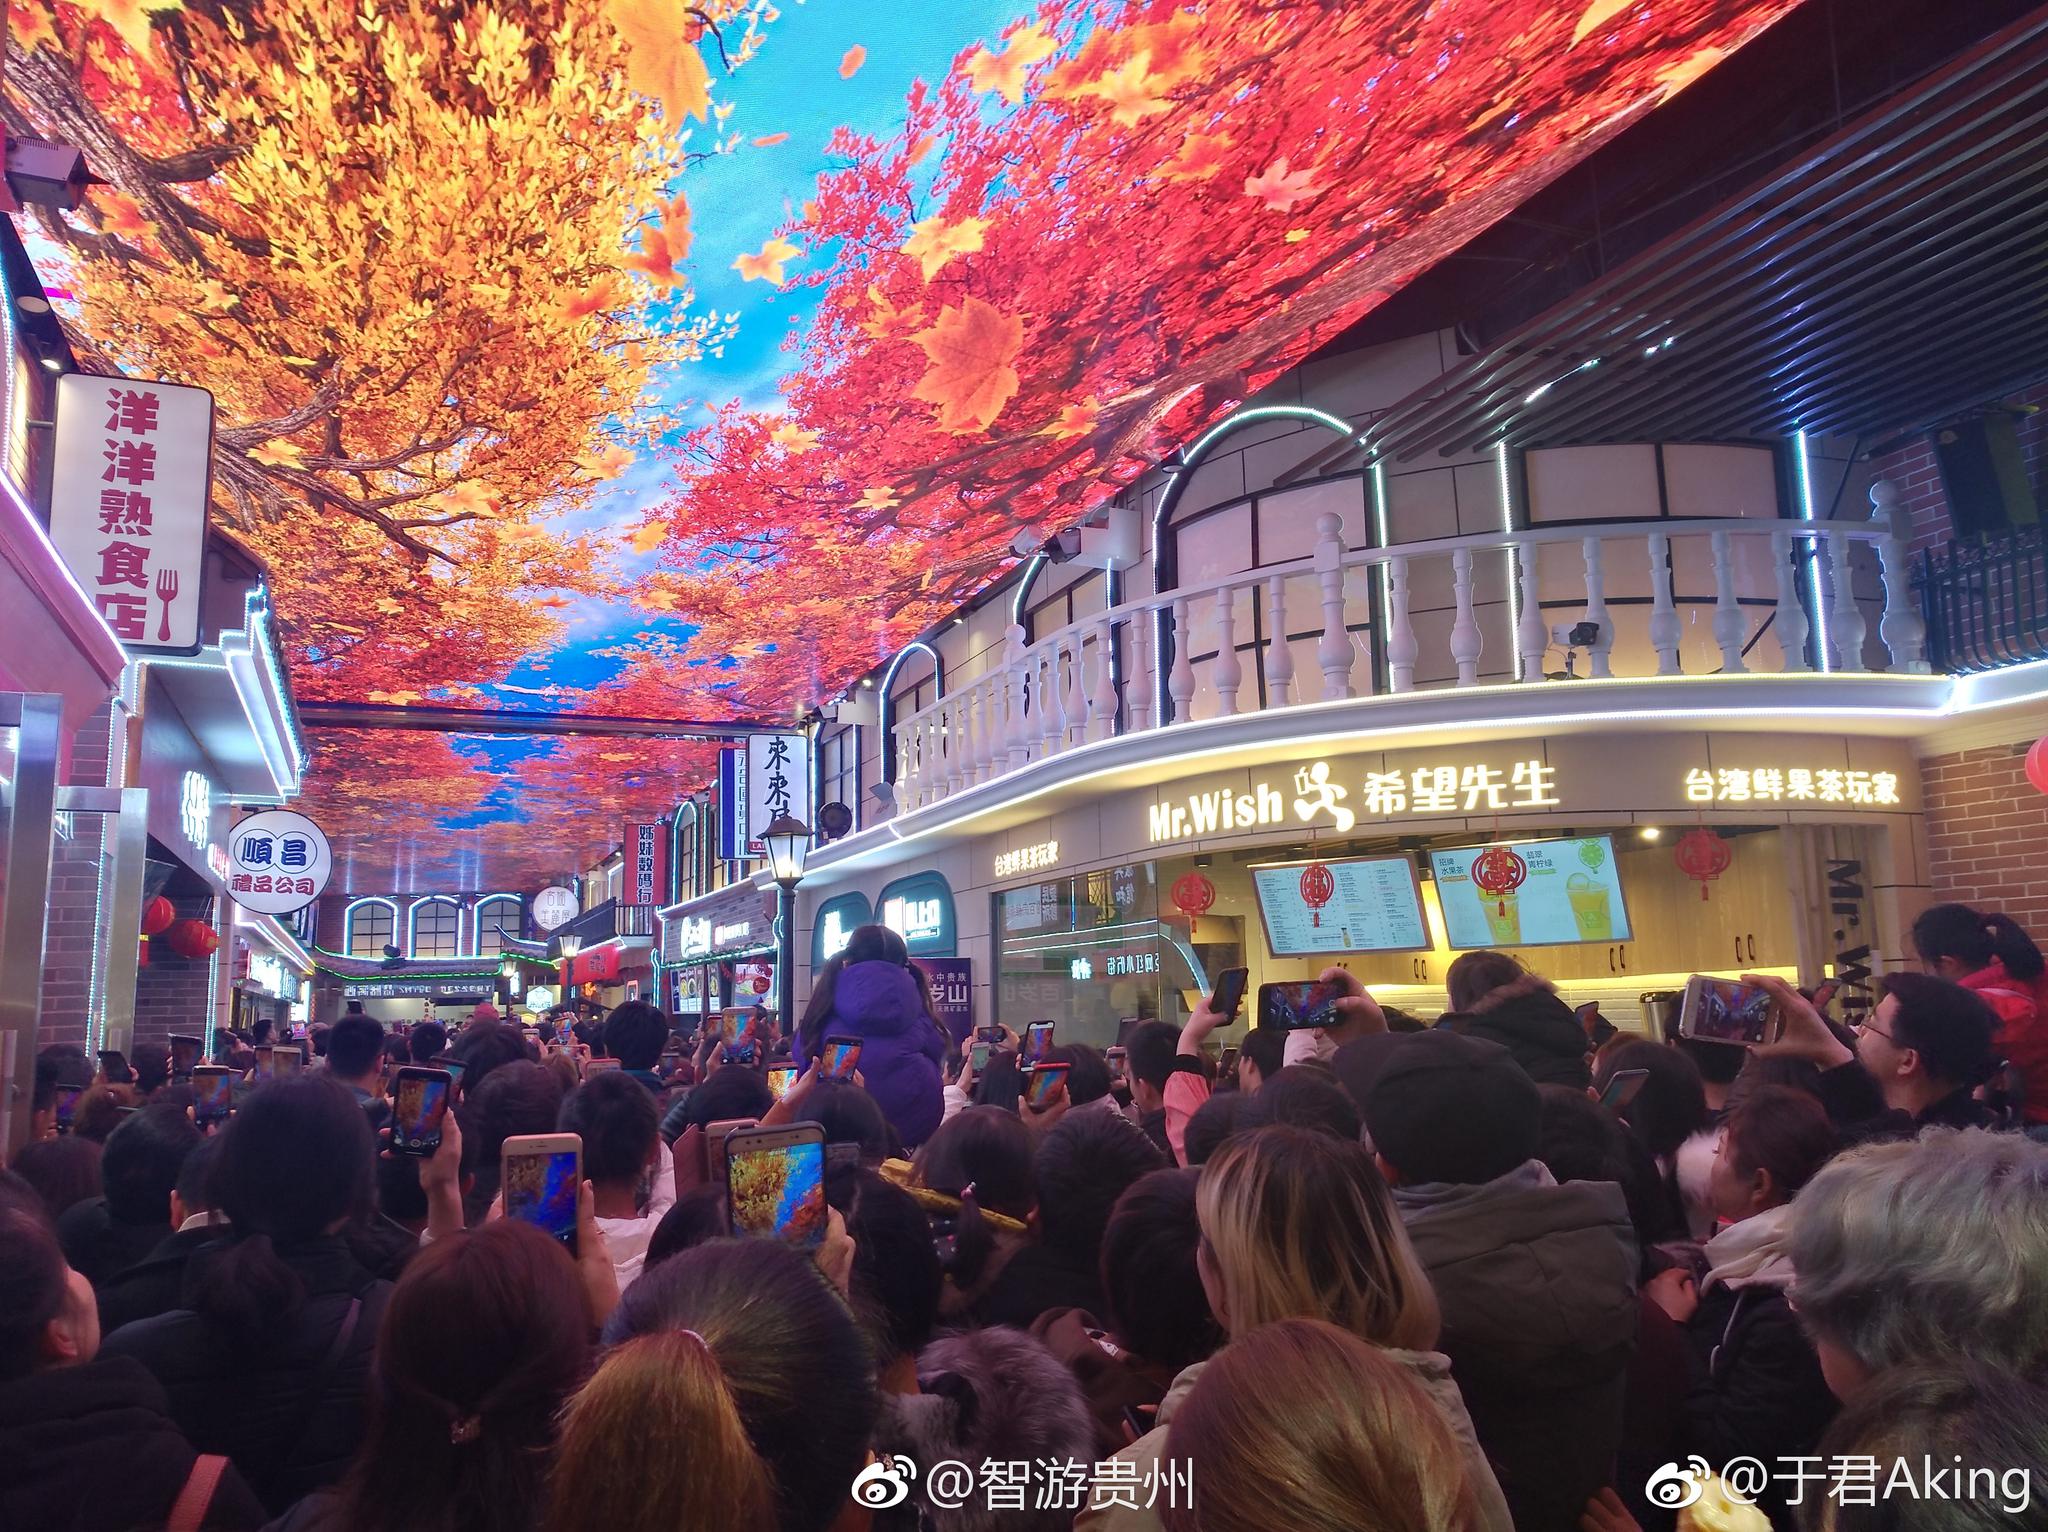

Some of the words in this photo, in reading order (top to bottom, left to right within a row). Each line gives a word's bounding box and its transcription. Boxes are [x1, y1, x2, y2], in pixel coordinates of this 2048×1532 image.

[95, 388, 160, 640] 洋洋熟食店
[1364, 760, 1560, 814] 希望先生
[1685, 768, 1900, 803] 台湾鲜果茶玩家
[1150, 784, 1282, 842] Mr.Wish
[241, 837, 307, 867] 順昌
[231, 874, 315, 896] 禮品公司
